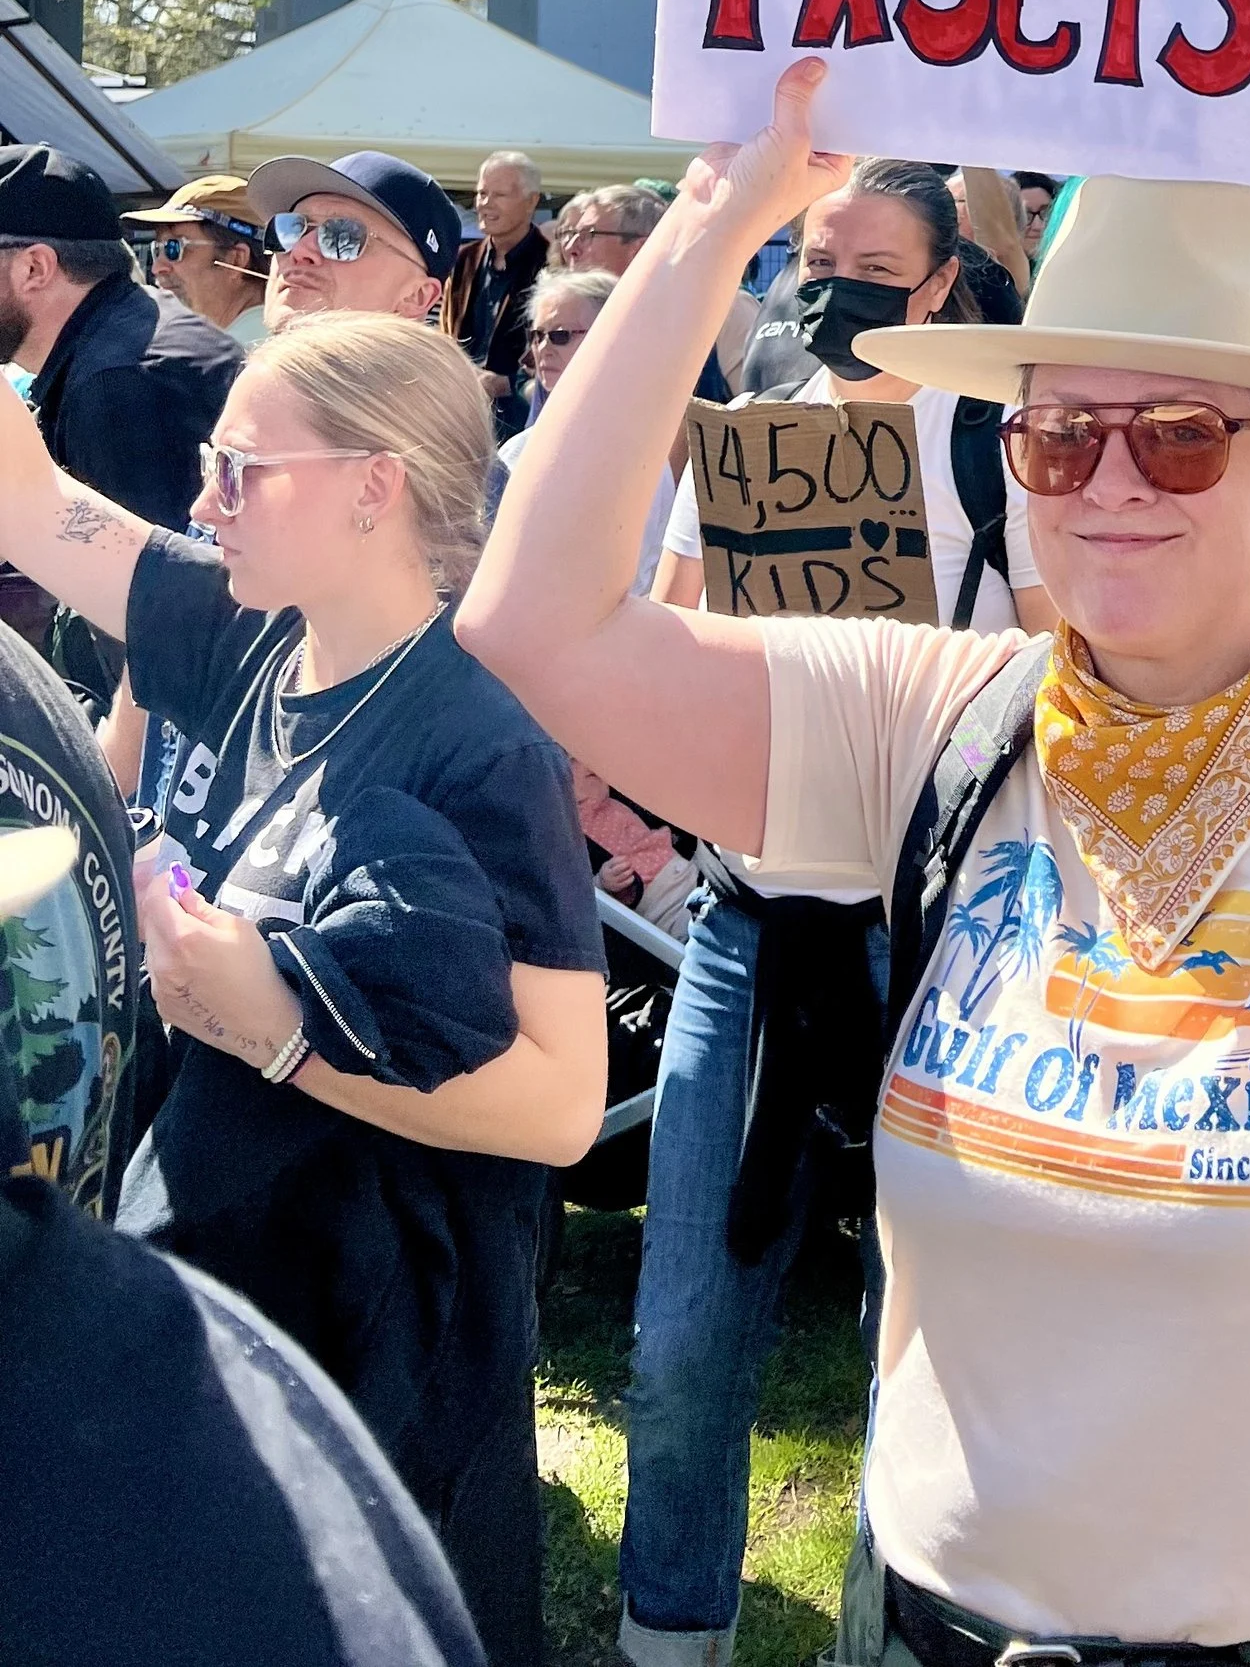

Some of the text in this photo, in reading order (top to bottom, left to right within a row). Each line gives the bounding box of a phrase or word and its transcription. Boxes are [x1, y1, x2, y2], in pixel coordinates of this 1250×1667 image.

[727, 549, 905, 616] KIDS
[83, 852, 126, 1011] COUNTY
[903, 986, 1029, 1094] Gulf
[1024, 1047, 1100, 1121] Of
